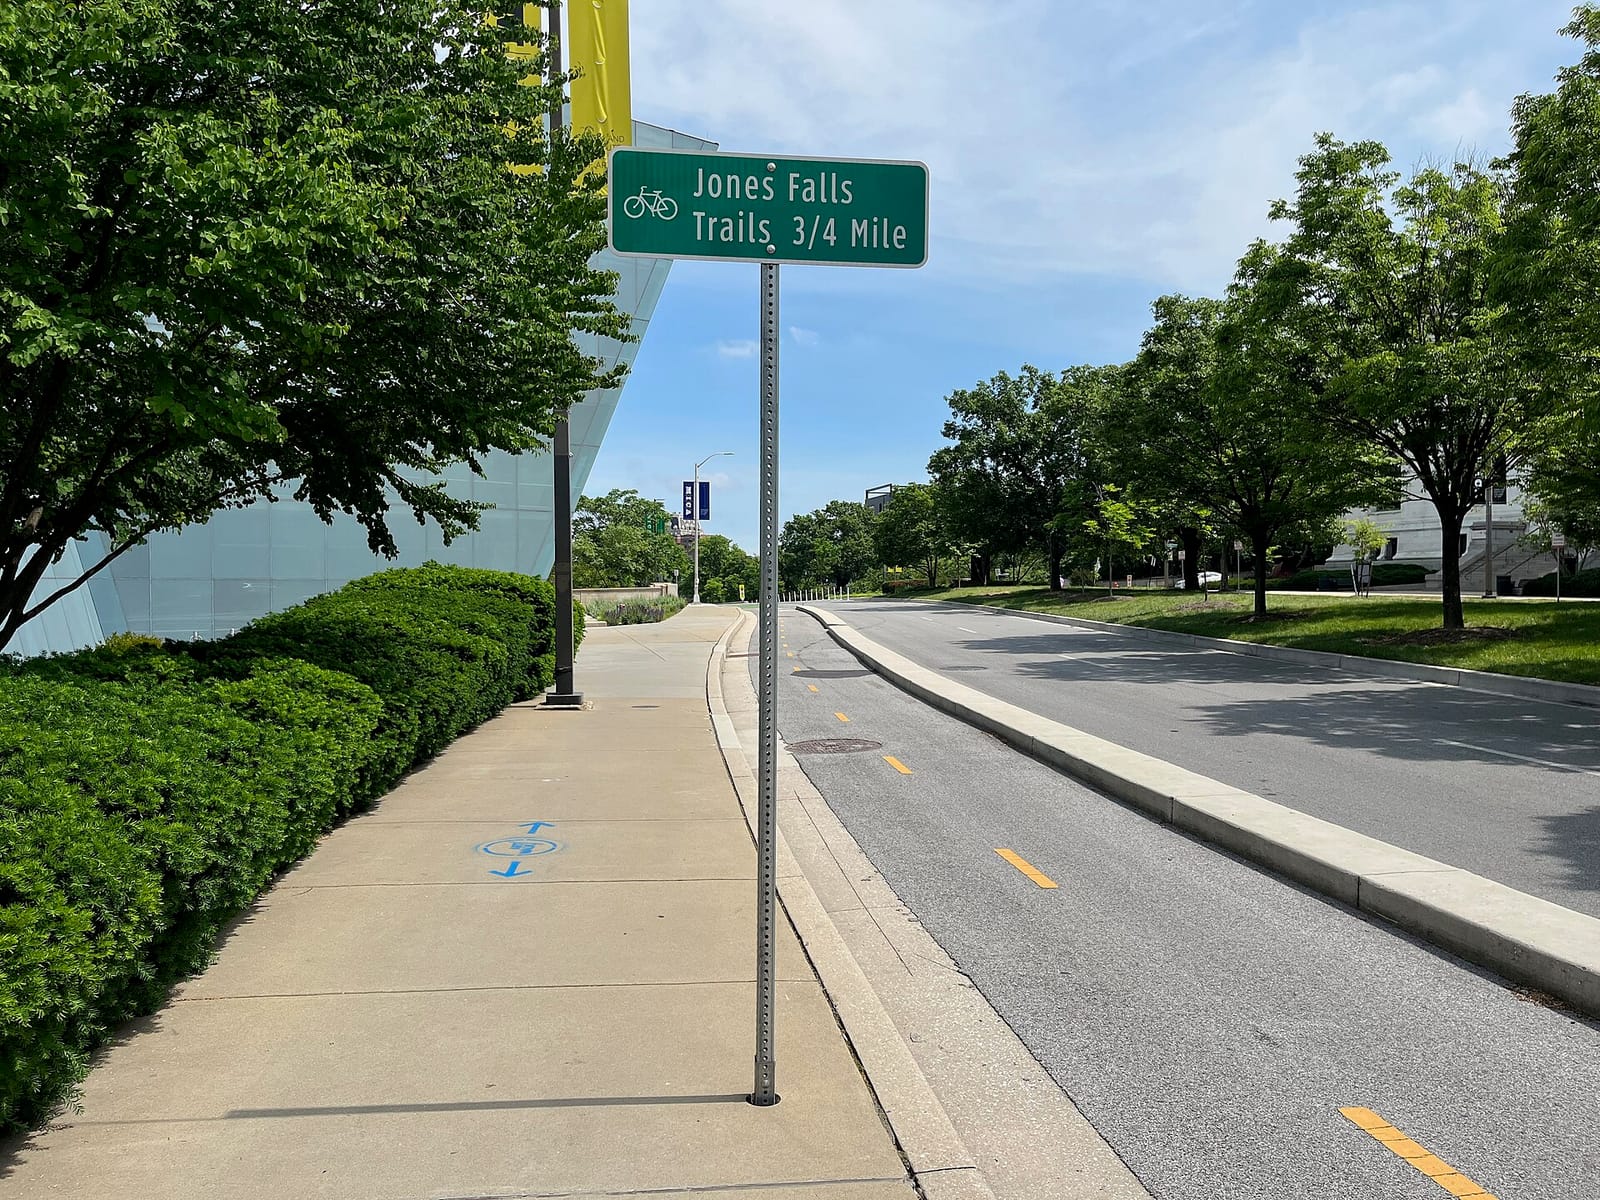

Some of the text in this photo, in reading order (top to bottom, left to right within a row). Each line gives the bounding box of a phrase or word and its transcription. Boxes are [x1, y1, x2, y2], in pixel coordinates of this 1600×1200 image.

[693, 168, 853, 204] Jones Falls
[693, 211, 906, 250] Trails 3/4 Mile
